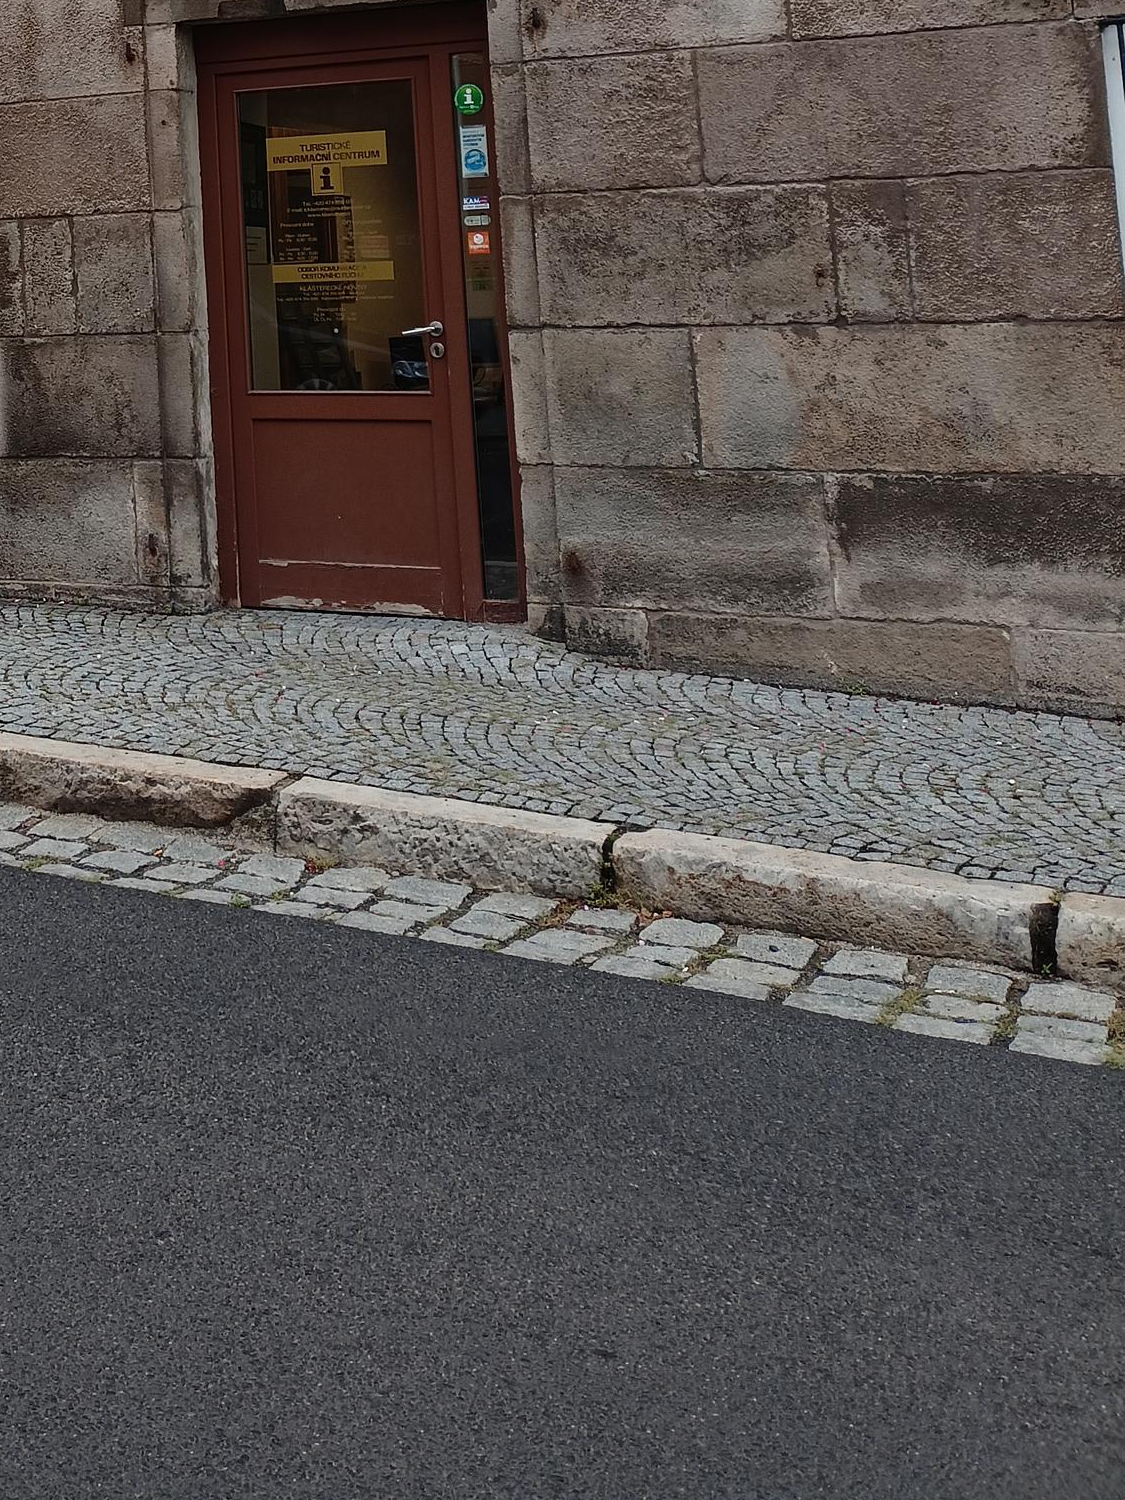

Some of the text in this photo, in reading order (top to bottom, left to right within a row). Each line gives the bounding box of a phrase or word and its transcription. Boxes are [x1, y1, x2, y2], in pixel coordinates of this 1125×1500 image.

[299, 141, 351, 152] TURISTICKÉ
[272, 150, 380, 164] INFORMAČNÍ CENTRUM
